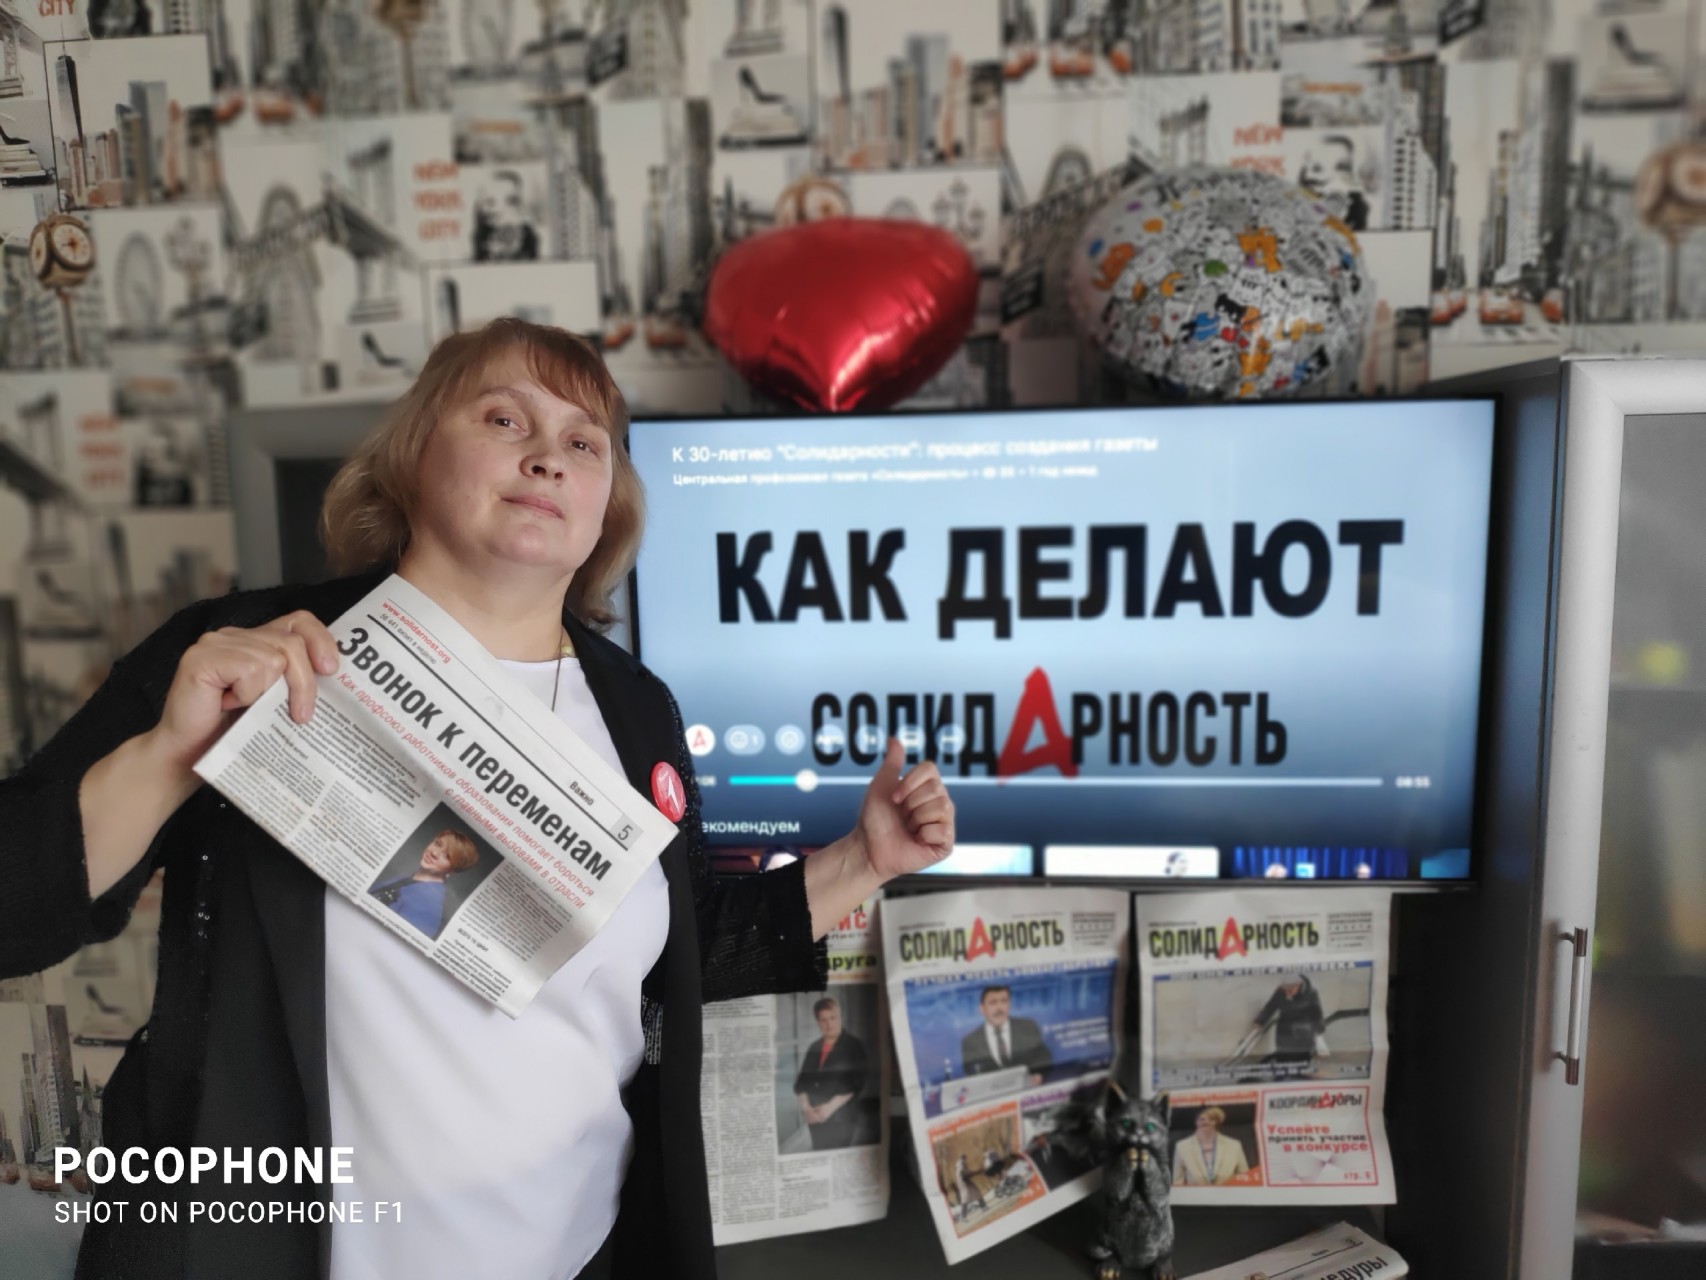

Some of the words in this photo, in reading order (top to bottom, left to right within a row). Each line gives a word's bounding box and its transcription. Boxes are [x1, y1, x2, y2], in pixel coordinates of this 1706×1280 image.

[672, 447, 684, 463] К
[689, 446, 773, 463] 30-летию
[1094, 436, 1159, 454] газеты
[672, 473, 748, 486] Центральная
[715, 528, 909, 624] КАК
[936, 518, 1406, 640] ДЕЛАЮТ
[382, 602, 452, 665] www.solidarnost.org
[811, 666, 1288, 783] СОЛИДАРНОСТЬ
[336, 627, 443, 730] Звонок
[436, 721, 465, 750] к
[459, 741, 612, 881] переменам
[337, 673, 359, 692] Как
[356, 690, 405, 734] профсоюз
[401, 732, 457, 780] работников
[456, 777, 514, 827] образования
[513, 825, 556, 865] помогает
[553, 860, 595, 898] бороться
[569, 781, 595, 806] Важно
[618, 824, 634, 841] 5
[701, 821, 801, 837] екомендуем
[451, 795, 498, 836] главными
[495, 832, 543, 874] вызовами
[540, 869, 548, 880] в
[547, 875, 586, 909] отрасли
[900, 916, 1065, 963] СОЛИДАРНОСТЬ
[1149, 916, 1319, 961] СОЛИДАРНОСТЬ
[1268, 1124, 1330, 1135] Успейте
[1268, 1135, 1315, 1144] принять
[1319, 1135, 1366, 1143] участие
[1283, 1144, 1292, 1153] в
[1296, 1143, 1368, 1154] конкурсе
